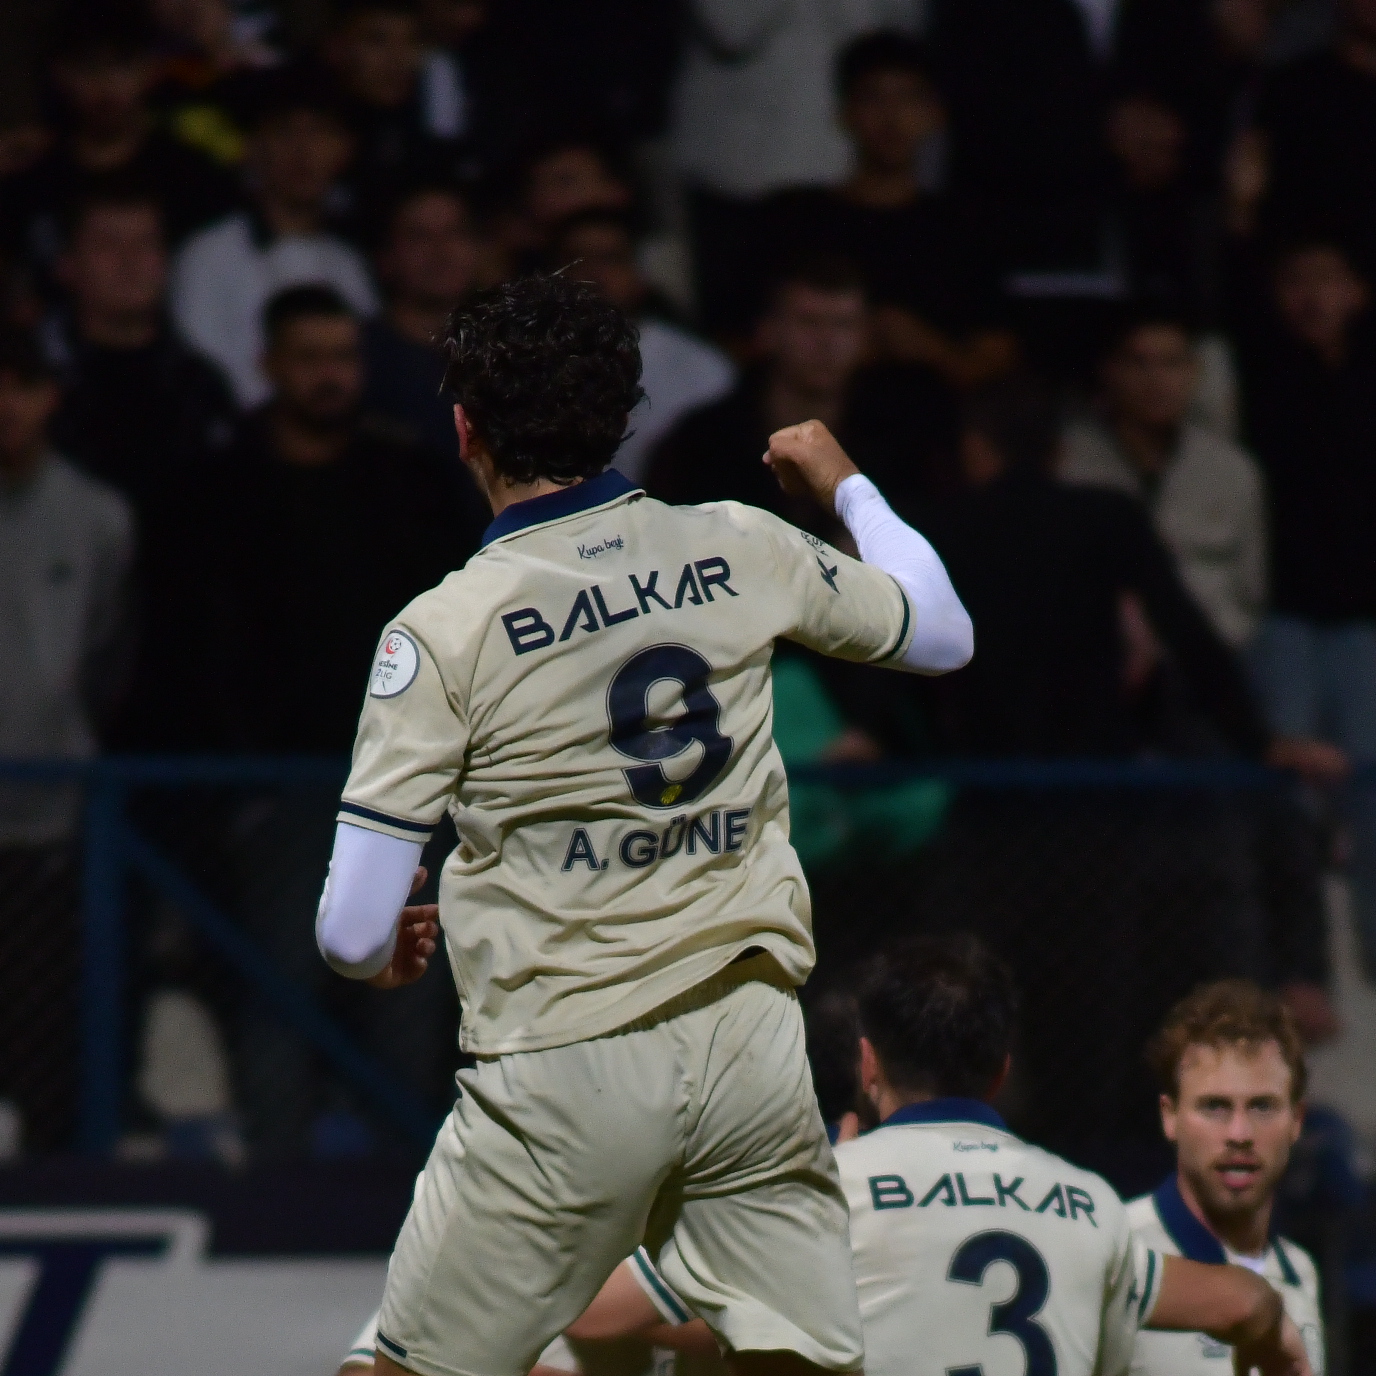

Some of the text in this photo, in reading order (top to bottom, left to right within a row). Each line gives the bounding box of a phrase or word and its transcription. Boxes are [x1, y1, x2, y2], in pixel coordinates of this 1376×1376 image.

[501, 556, 740, 656] BALKAR
[605, 642, 734, 810] 9
[868, 1172, 1099, 1228] BALKAR
